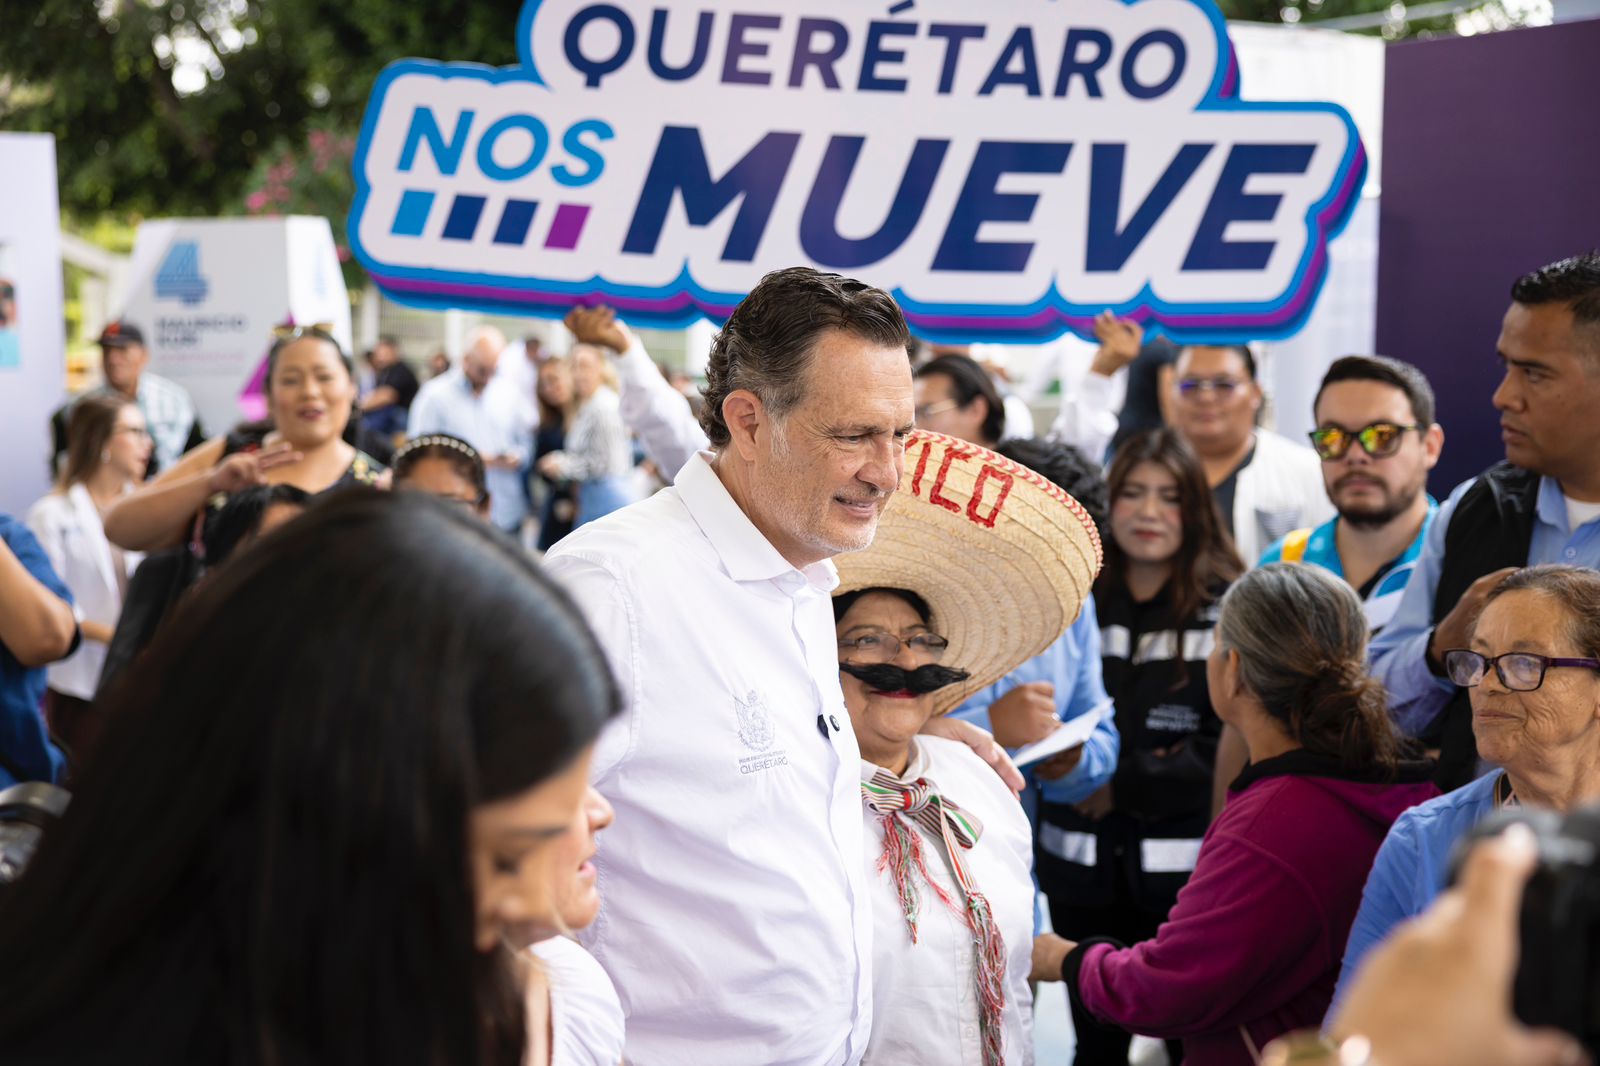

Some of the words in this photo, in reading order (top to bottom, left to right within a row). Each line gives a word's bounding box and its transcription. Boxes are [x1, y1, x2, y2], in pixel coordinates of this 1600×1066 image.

[563, 0, 1189, 101] QUERÉTARO
[397, 106, 617, 188] NOS
[620, 125, 1319, 272] MUEVE
[904, 438, 1014, 529] ICO
